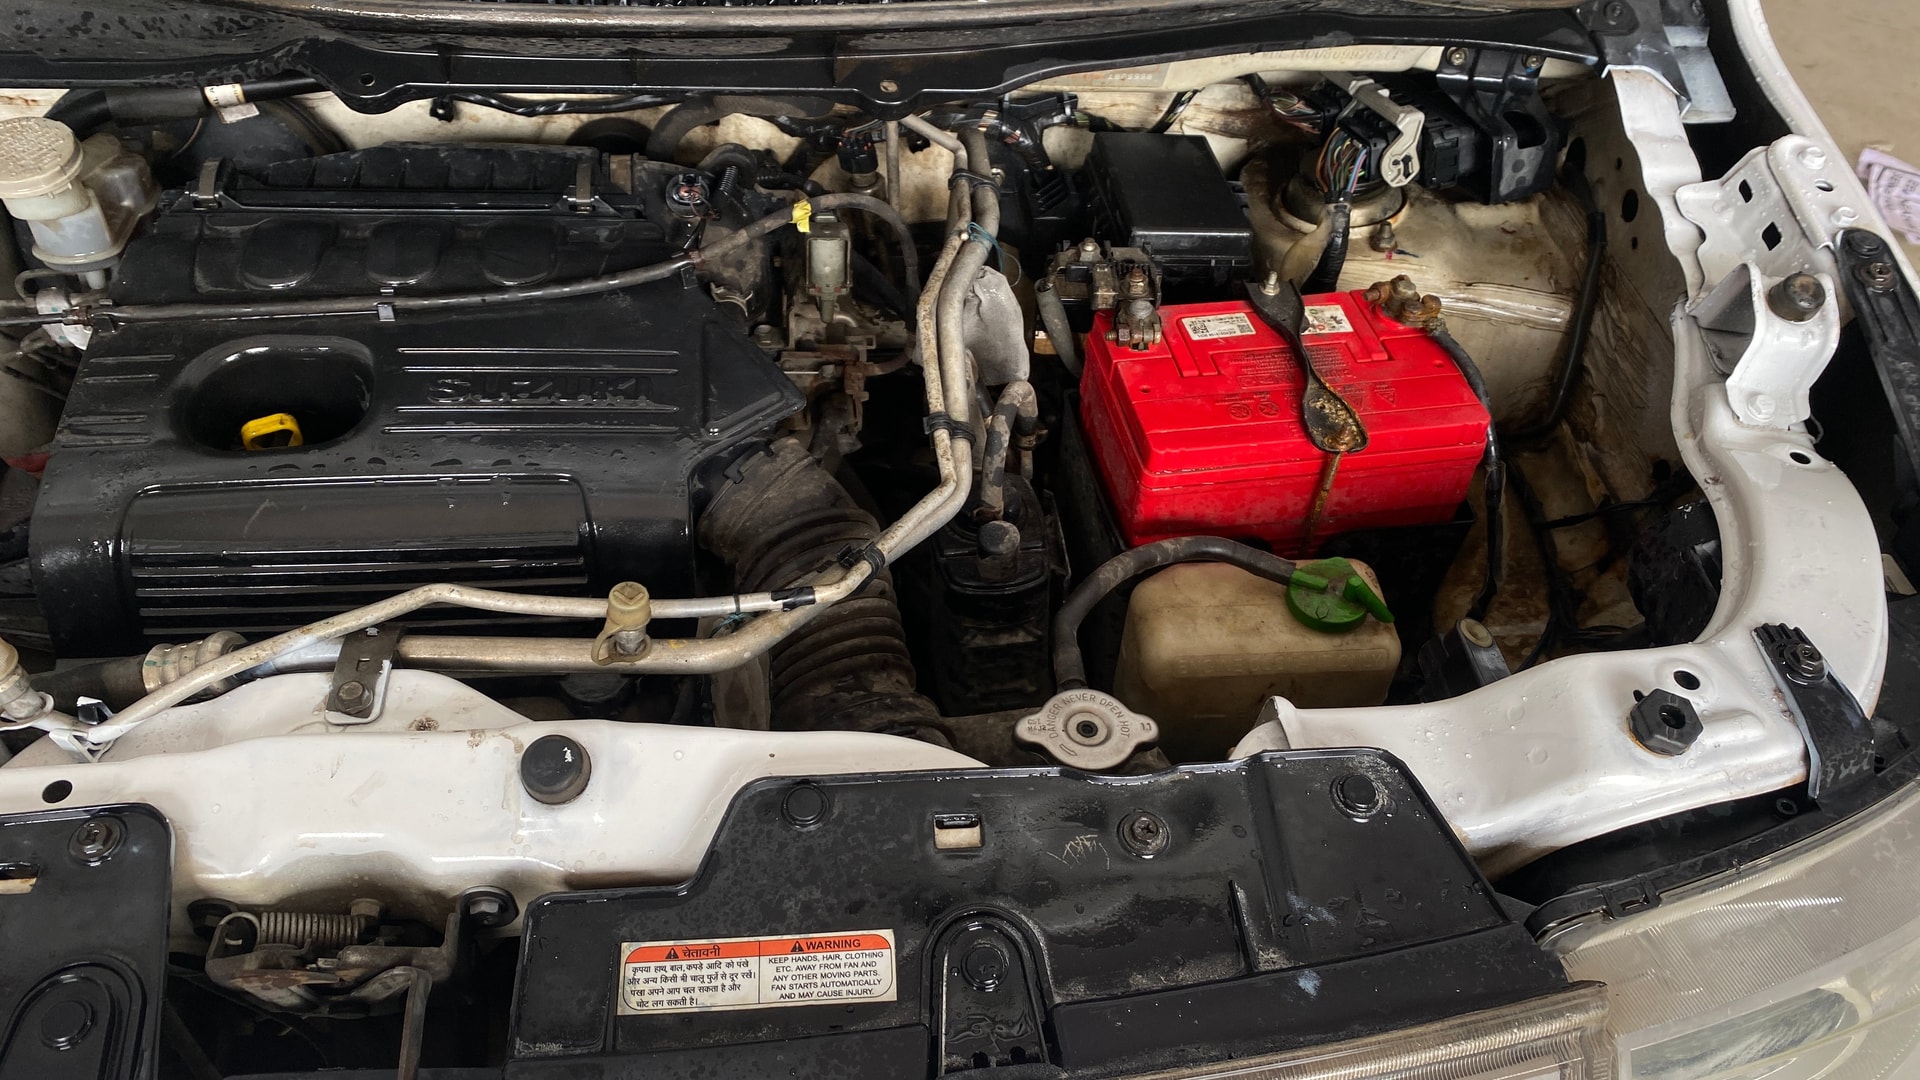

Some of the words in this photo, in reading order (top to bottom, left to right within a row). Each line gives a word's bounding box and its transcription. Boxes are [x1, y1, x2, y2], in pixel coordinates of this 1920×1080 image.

[428, 375, 656, 404] SUZUKI
[1048, 703, 1062, 738] DANGER
[1062, 693, 1096, 705] NEVER
[1099, 698, 1125, 718] OPEN
[1120, 720, 1132, 738] HOT
[806, 939, 860, 950] WARNING
[682, 945, 720, 958] चेतावनी
[845, 951, 883, 960] CLOTHING
[632, 966, 650, 976] कृपया
[725, 960, 734, 968] को
[720, 971, 726, 980] से
[721, 983, 726, 992] है
[821, 979, 882, 988] AUTOMATICALLY
